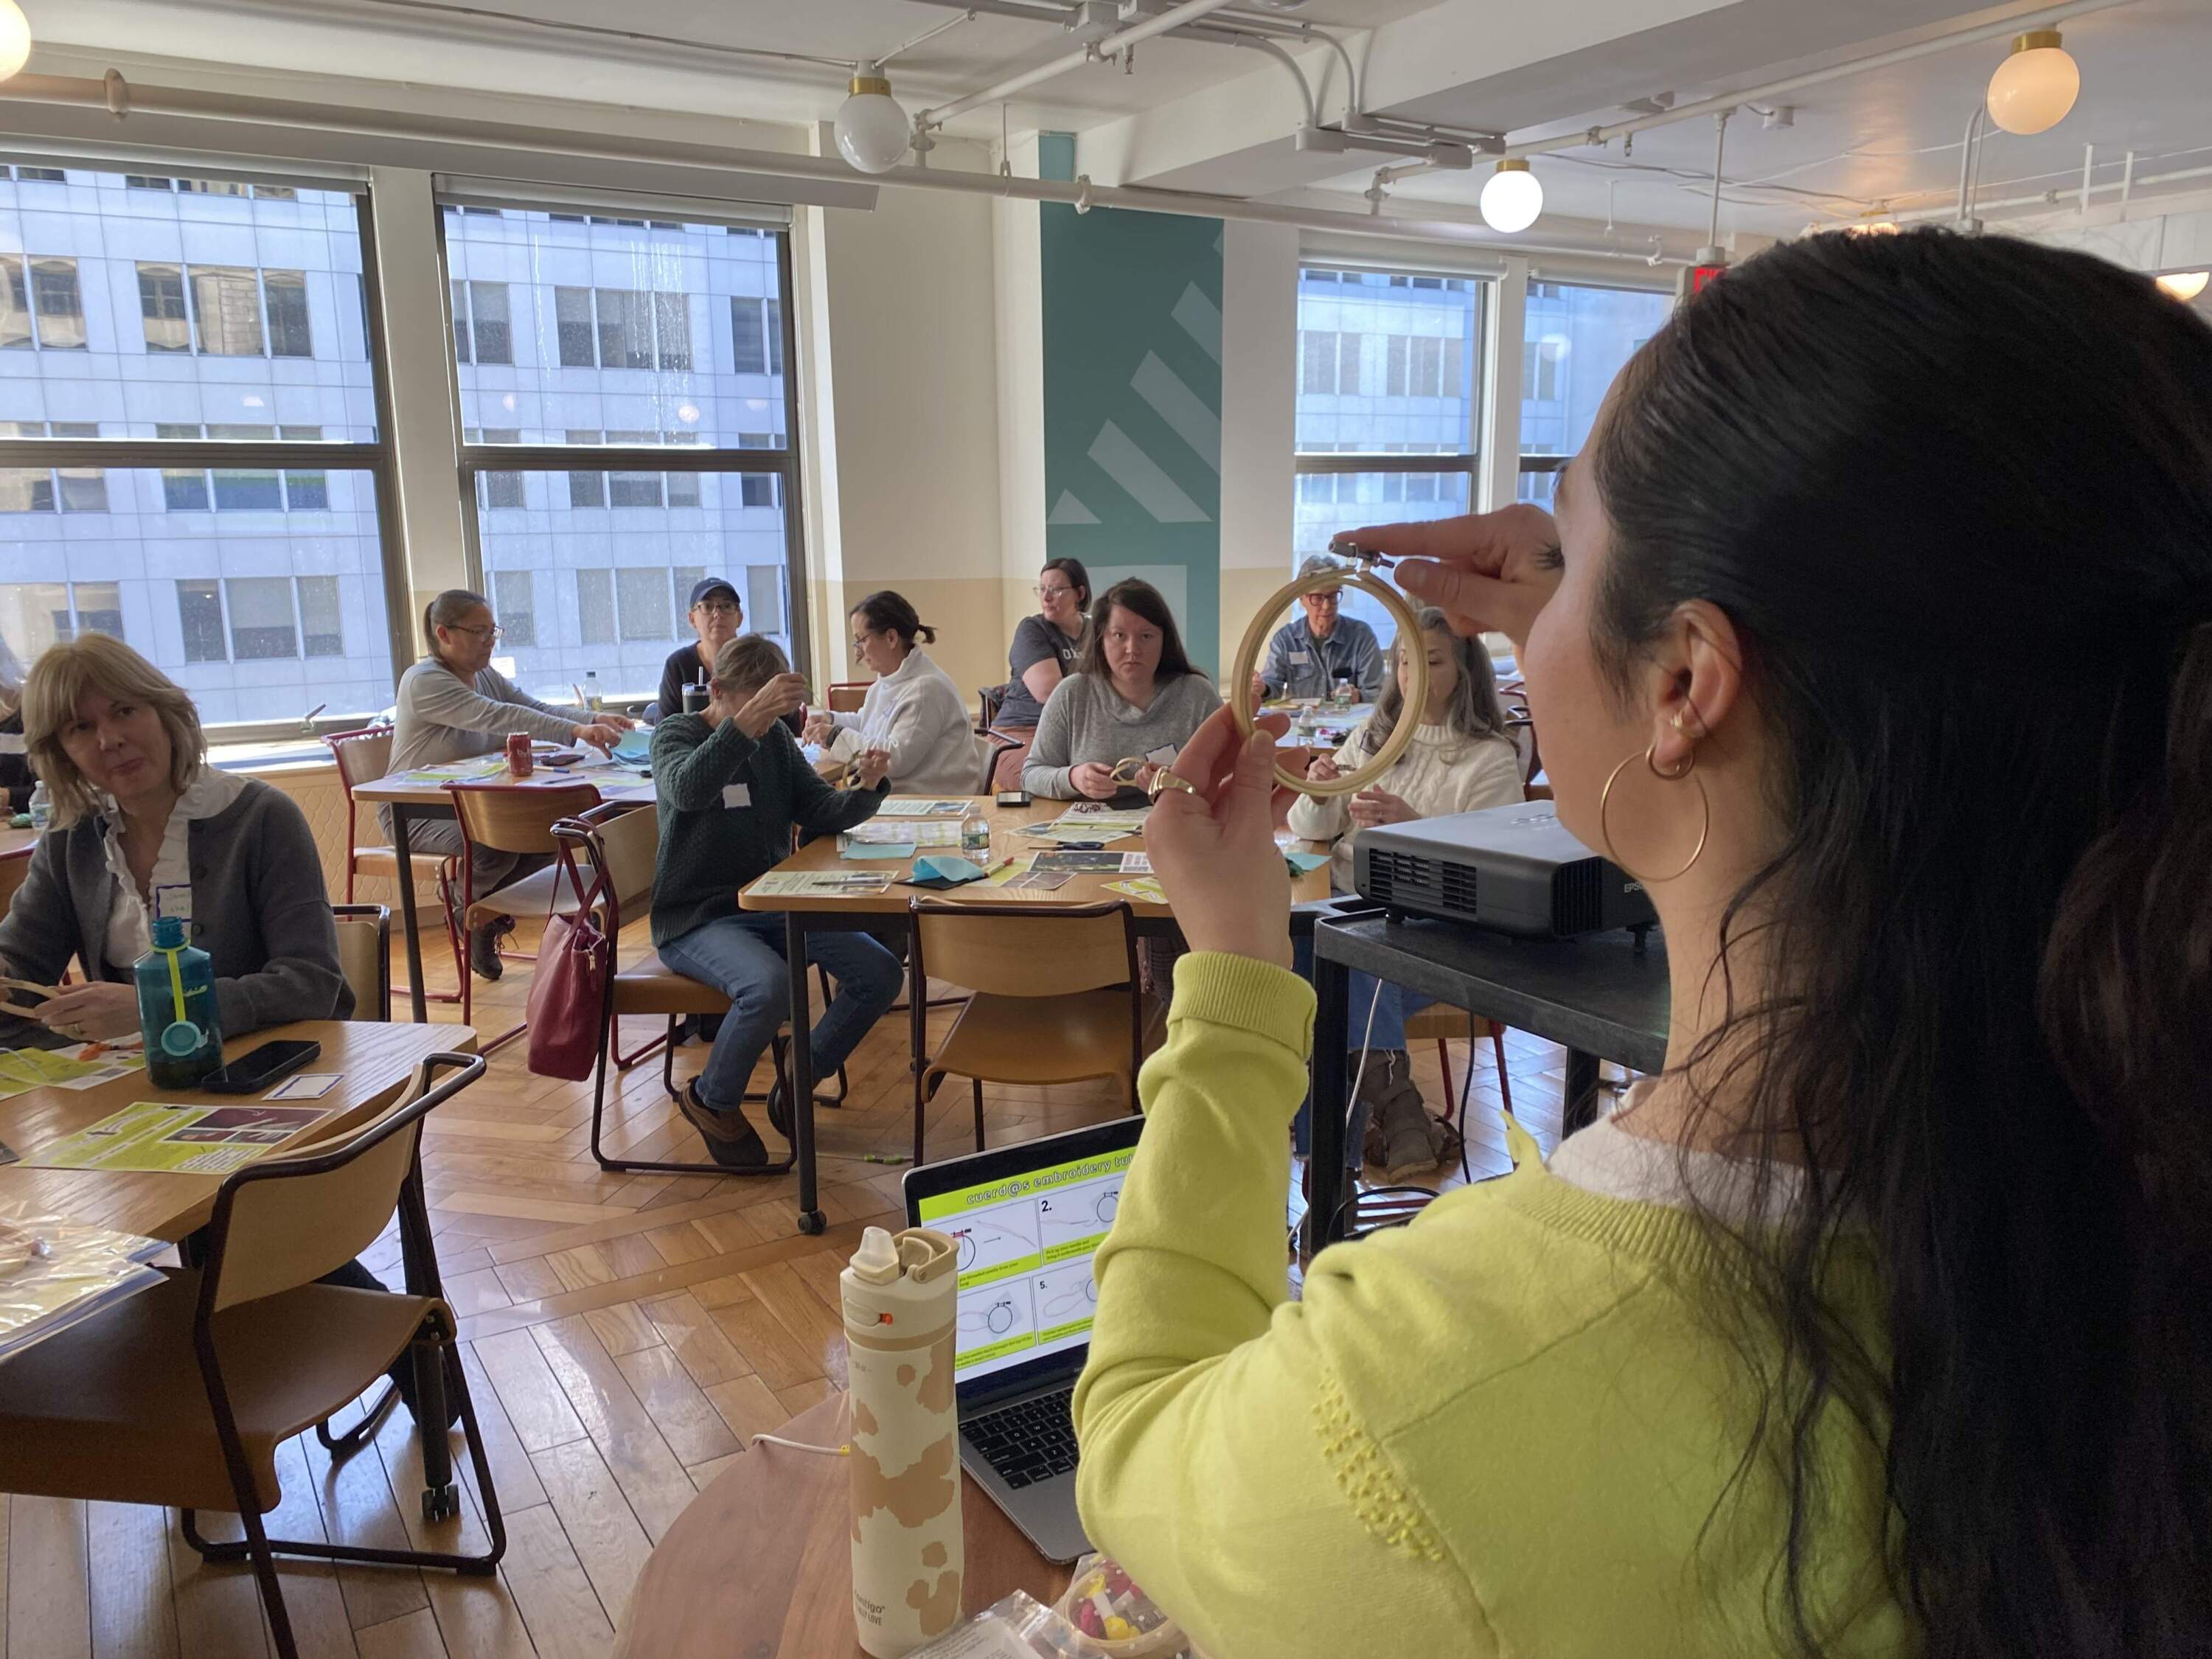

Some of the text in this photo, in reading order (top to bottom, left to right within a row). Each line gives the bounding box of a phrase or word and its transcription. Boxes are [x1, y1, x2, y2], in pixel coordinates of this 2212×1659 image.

[967, 1181, 1029, 1204] cuerd@s
[1034, 1160, 1111, 1186] embroidery
[1041, 1200, 1052, 1212] 2.
[1040, 1281, 1048, 1289] 5.
